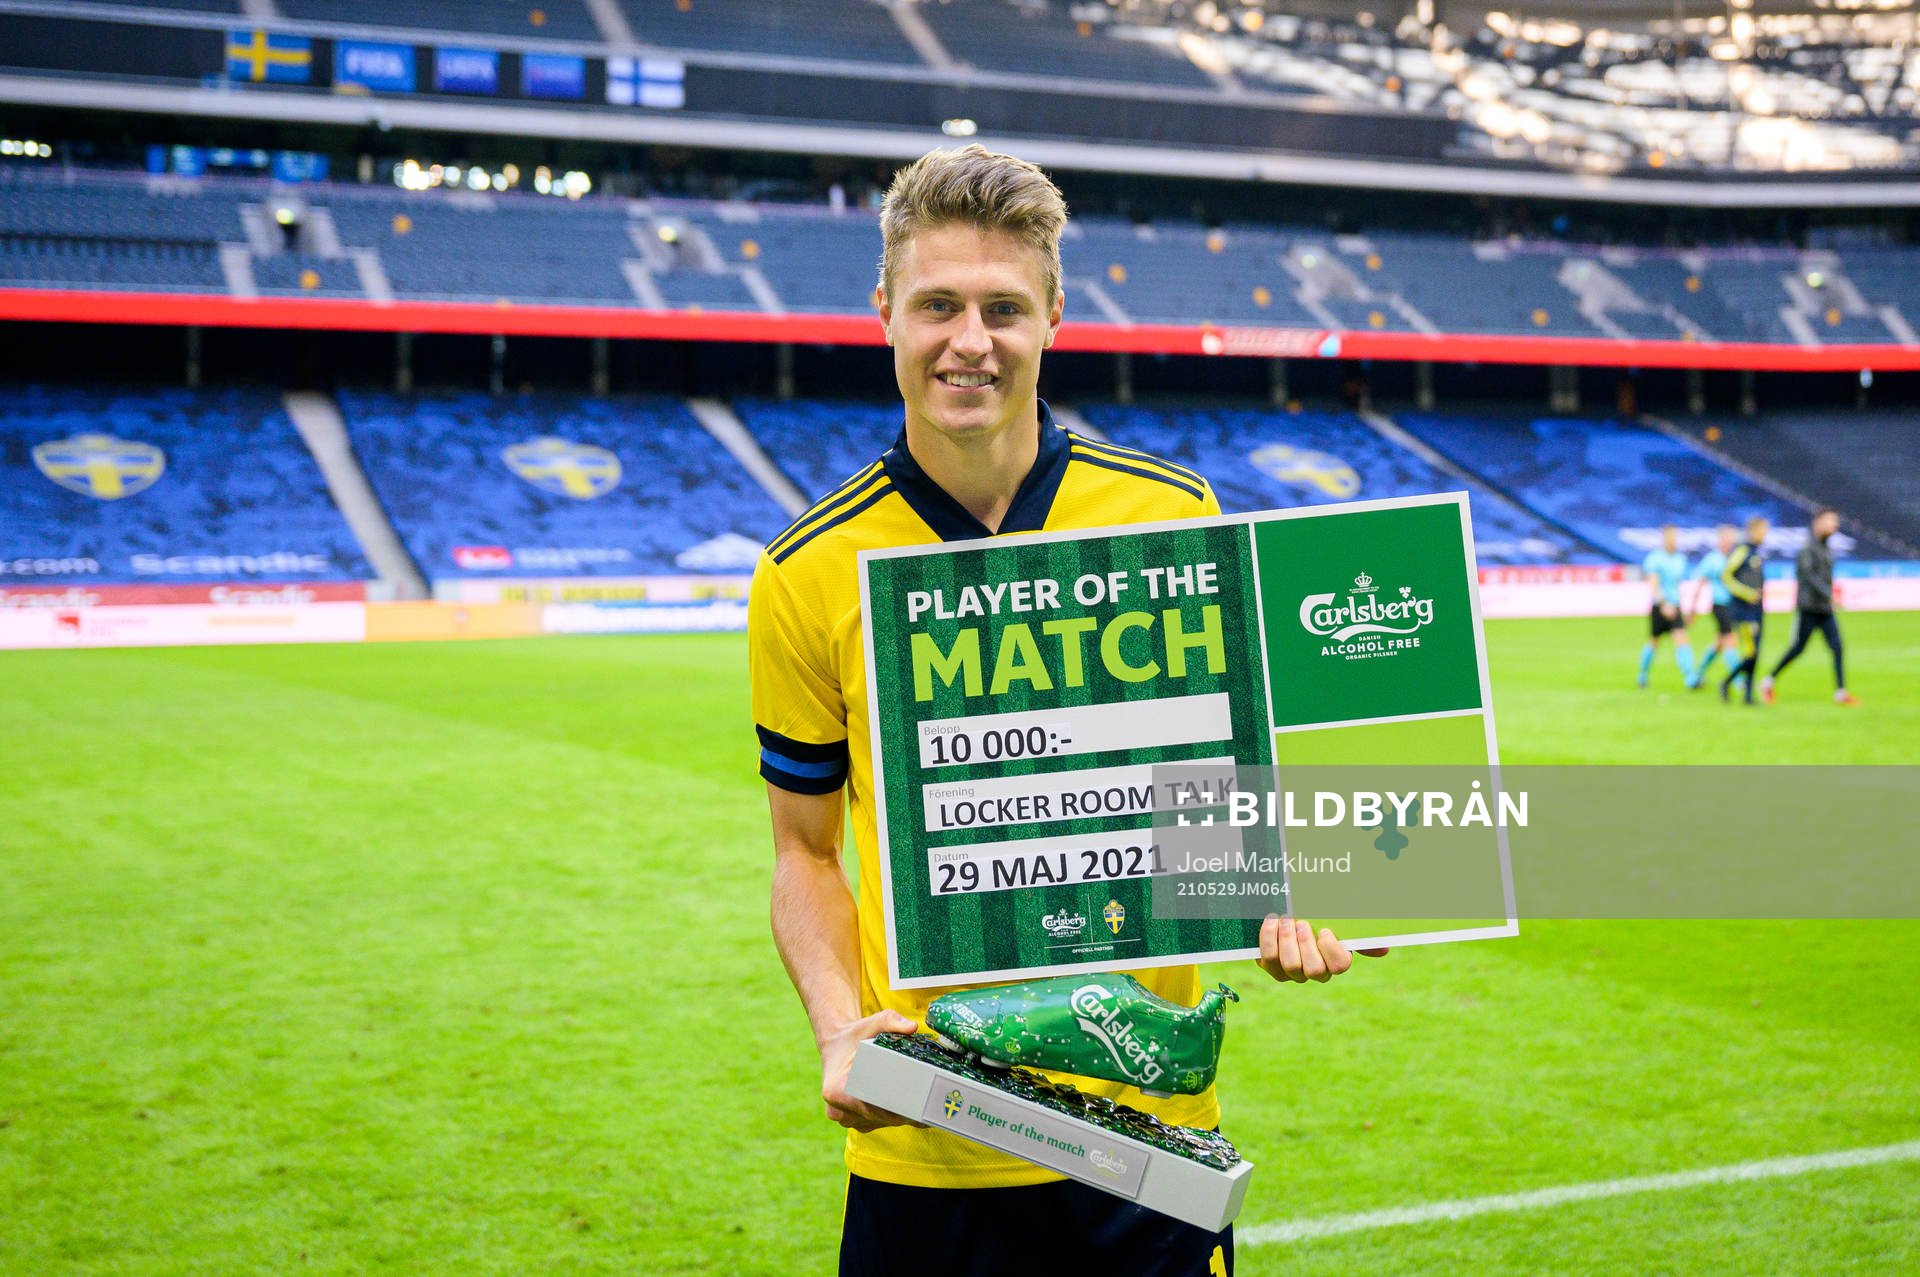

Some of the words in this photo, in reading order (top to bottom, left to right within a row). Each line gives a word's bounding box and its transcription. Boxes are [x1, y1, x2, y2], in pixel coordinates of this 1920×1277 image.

[907, 579, 1061, 622] PLAYER
[1074, 571, 1129, 606] OF
[1140, 563, 1219, 600] THE
[1299, 592, 1434, 636] Carlsberg
[910, 605, 1227, 702] MATCH
[1321, 642, 1384, 656] ALCOHOL
[1388, 638, 1420, 650] FREE
[923, 725, 960, 737] Belopp
[930, 733, 972, 765] 10
[982, 726, 1072, 758] 000:-
[928, 786, 975, 800] Förening
[940, 794, 1051, 827] LOCKER
[1061, 784, 1157, 817] ROOM
[1165, 776, 1235, 806] TALK
[934, 852, 969, 864] Datum
[938, 861, 981, 893] 29
[992, 852, 1068, 889] MAJ
[1080, 843, 1168, 880] 2021
[1041, 914, 1086, 931] Carlsberg
[1070, 984, 1164, 1085] Carlsberg
[968, 1104, 1007, 1129] Player
[1010, 1122, 1025, 1135] of
[1025, 1127, 1045, 1143] the
[1047, 1136, 1085, 1158] match
[1089, 1149, 1127, 1175] Carlsberg
